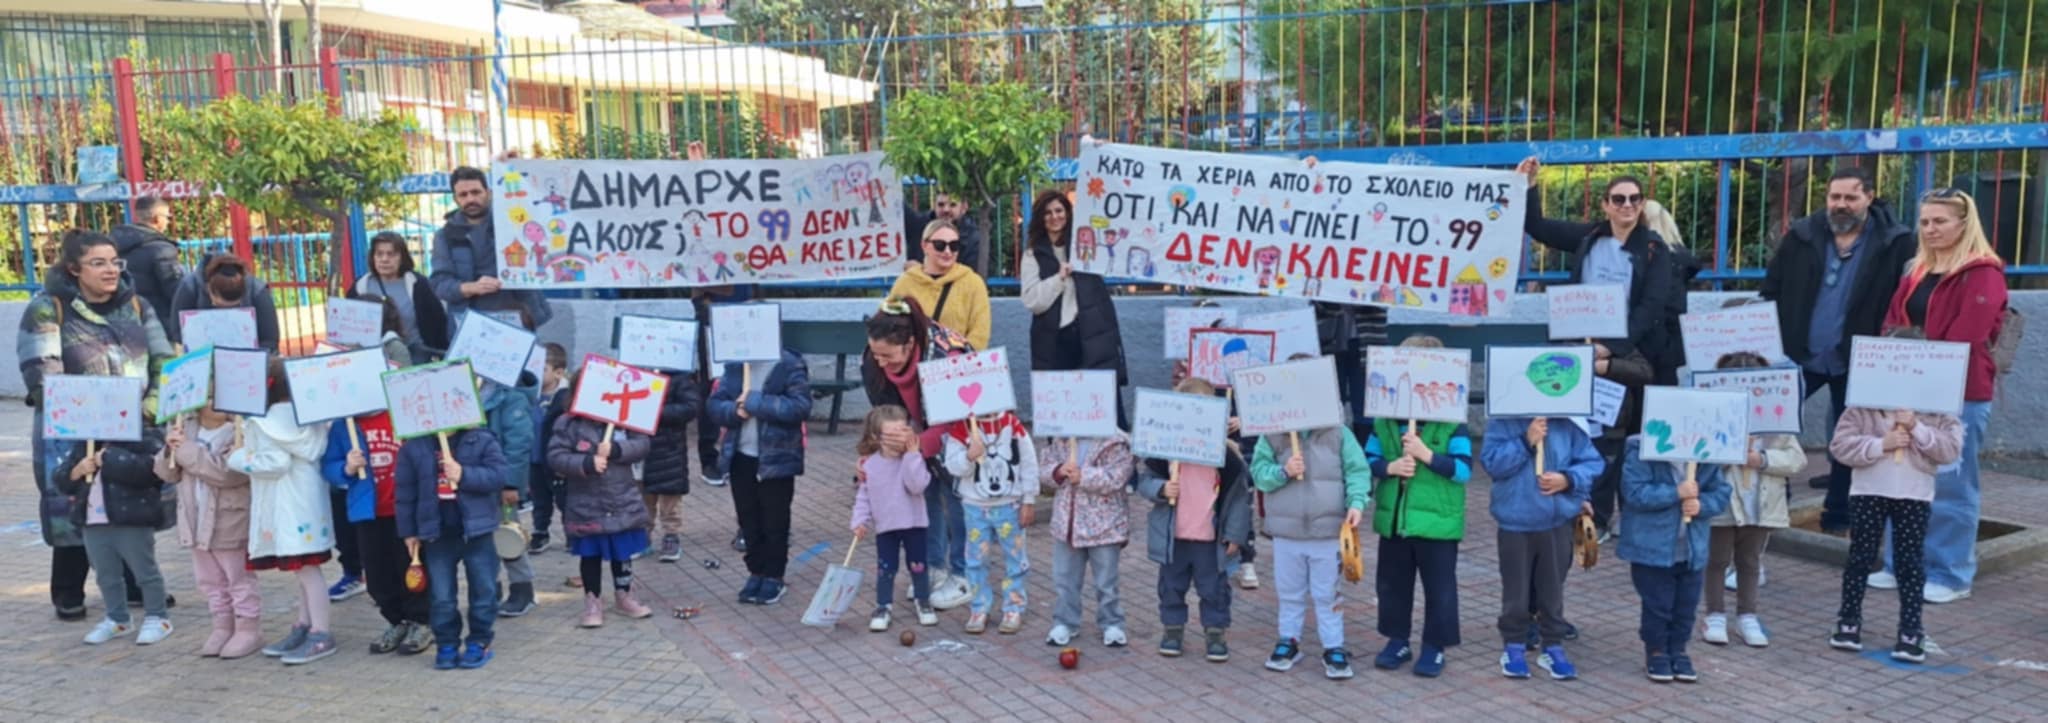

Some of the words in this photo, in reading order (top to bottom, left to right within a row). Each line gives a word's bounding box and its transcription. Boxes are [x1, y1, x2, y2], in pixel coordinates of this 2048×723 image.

[570, 169, 782, 210] ΔΗΜΑΡΧΕ
[1097, 155, 1144, 179] ΚΑΤΩ
[1160, 162, 1182, 182] ΤΑ
[1197, 166, 1256, 188] ΧΕΡΙΑ
[1269, 172, 1310, 193] ΑΠΟ
[1326, 174, 1352, 195] ΤΟ
[1366, 176, 1454, 199] ΣΧΟΛΕΙΟ
[1464, 182, 1511, 206] ΜΑΣ
[707, 211, 749, 238] ΤΟ
[758, 209, 791, 242] 99
[802, 209, 850, 236] ΔΕΝ
[1104, 193, 1155, 221] ΟΤΙ
[1172, 198, 1220, 229] ΚΑΙ
[1237, 206, 1275, 235] ΝΑ
[1290, 211, 1360, 241] ΓΙΝΕΙ
[1390, 216, 1429, 246] ΤΟ
[1448, 218, 1483, 251] 99
[748, 243, 787, 270] ΘΑ
[801, 232, 901, 264] ΚΛΕΙΣΕΙ
[1165, 232, 1252, 268] ΔΕΝ
[1286, 241, 1450, 288] ΚΛΕΙΝΕΙ
